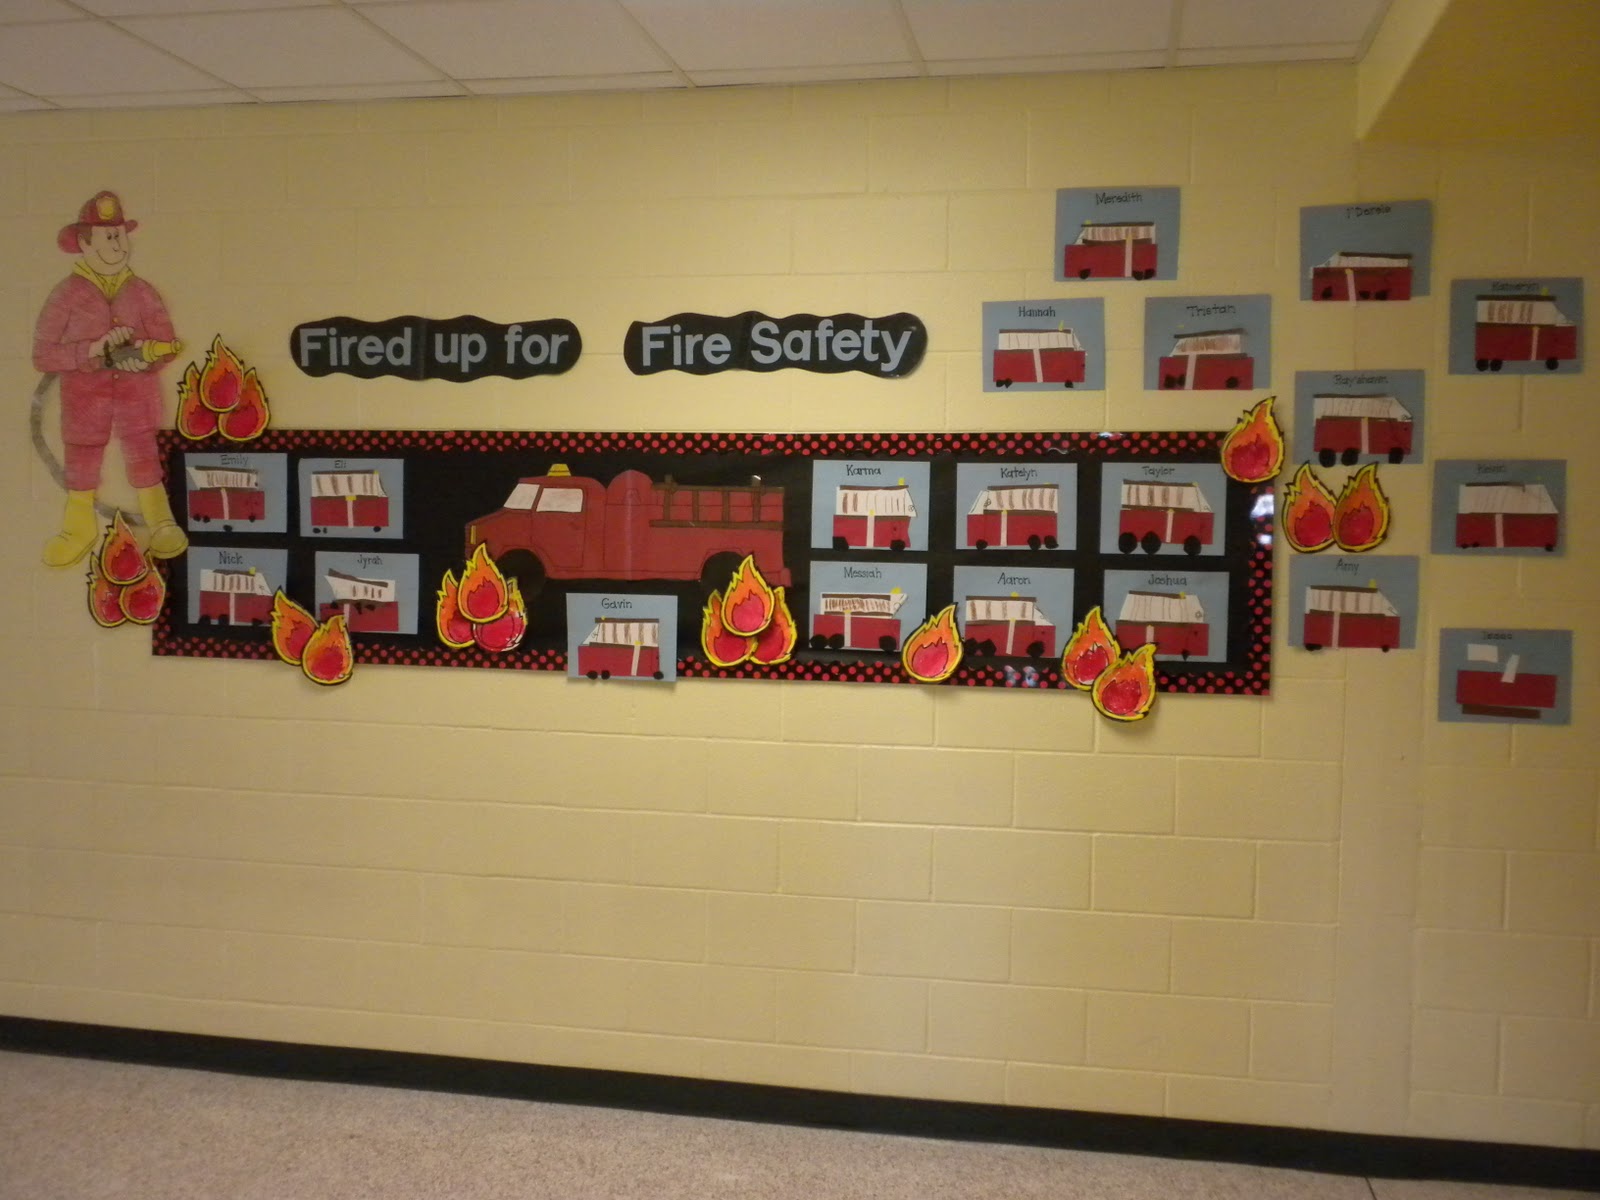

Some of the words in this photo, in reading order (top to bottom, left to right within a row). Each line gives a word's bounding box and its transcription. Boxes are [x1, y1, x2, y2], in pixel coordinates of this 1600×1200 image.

[1095, 191, 1143, 206] Meredith
[1018, 306, 1056, 317] Hannah
[1186, 303, 1236, 317] Tristan
[300, 327, 412, 367] Fired
[435, 331, 486, 372] up
[505, 325, 569, 365] for
[641, 324, 732, 367] Fire
[751, 319, 913, 372] Safety
[221, 455, 250, 466] Emily
[334, 459, 347, 469] Eli
[845, 464, 882, 476] Karma
[1000, 467, 1038, 480] Katelyn
[1141, 466, 1175, 478] Taylor
[218, 551, 243, 565] Nick
[357, 554, 384, 569] Jyrah
[843, 566, 882, 578] Messiah
[1335, 558, 1360, 576] Amy
[997, 572, 1031, 585] Aaron
[1148, 573, 1187, 586] Joshua
[601, 597, 633, 610] Gavin
